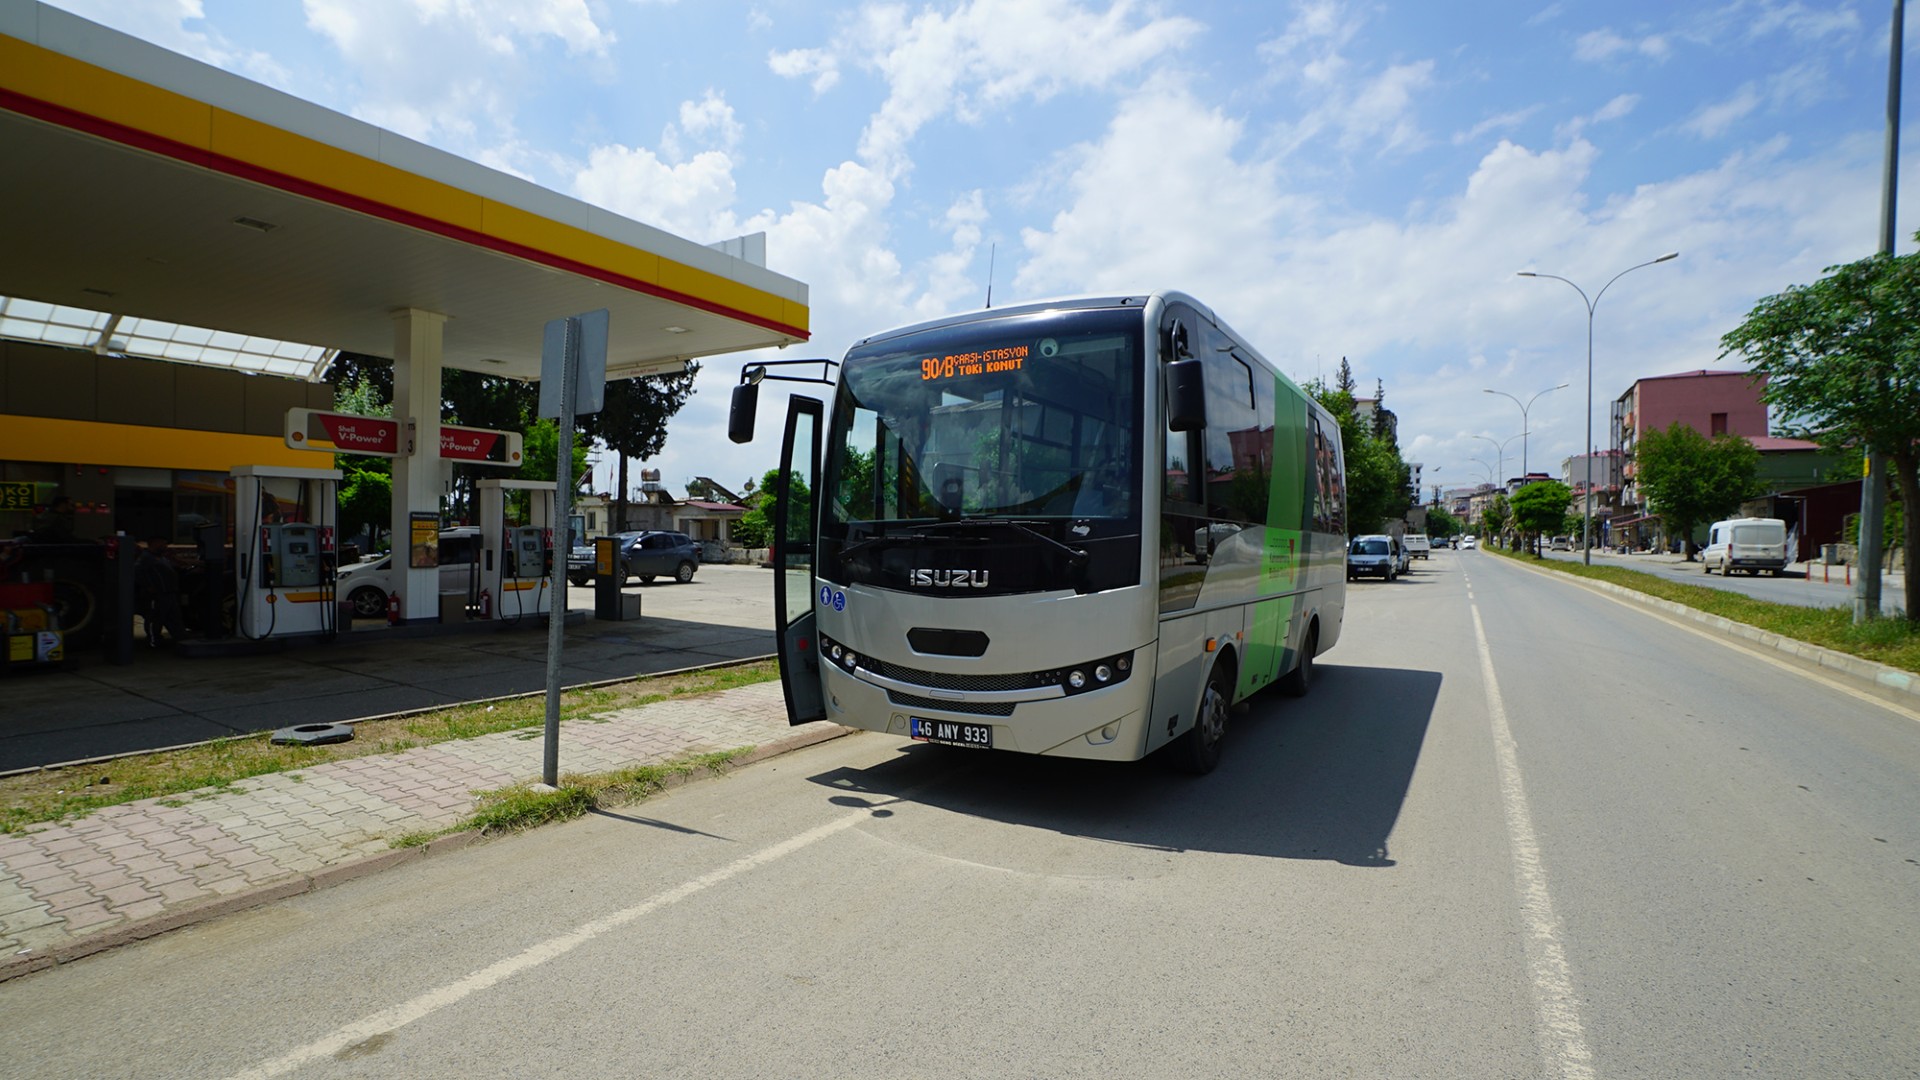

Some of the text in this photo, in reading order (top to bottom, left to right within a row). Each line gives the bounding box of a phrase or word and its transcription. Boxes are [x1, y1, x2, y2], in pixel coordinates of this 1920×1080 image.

[921, 356, 954, 380] 90/B
[986, 358, 1023, 373] KONUT
[338, 425, 356, 433] Shell
[338, 432, 383, 444] V-Power
[407, 440, 413, 452] 3
[440, 442, 478, 452] V-Power
[910, 569, 989, 588] ISUZU
[918, 721, 988, 743] 46 ANY 933
